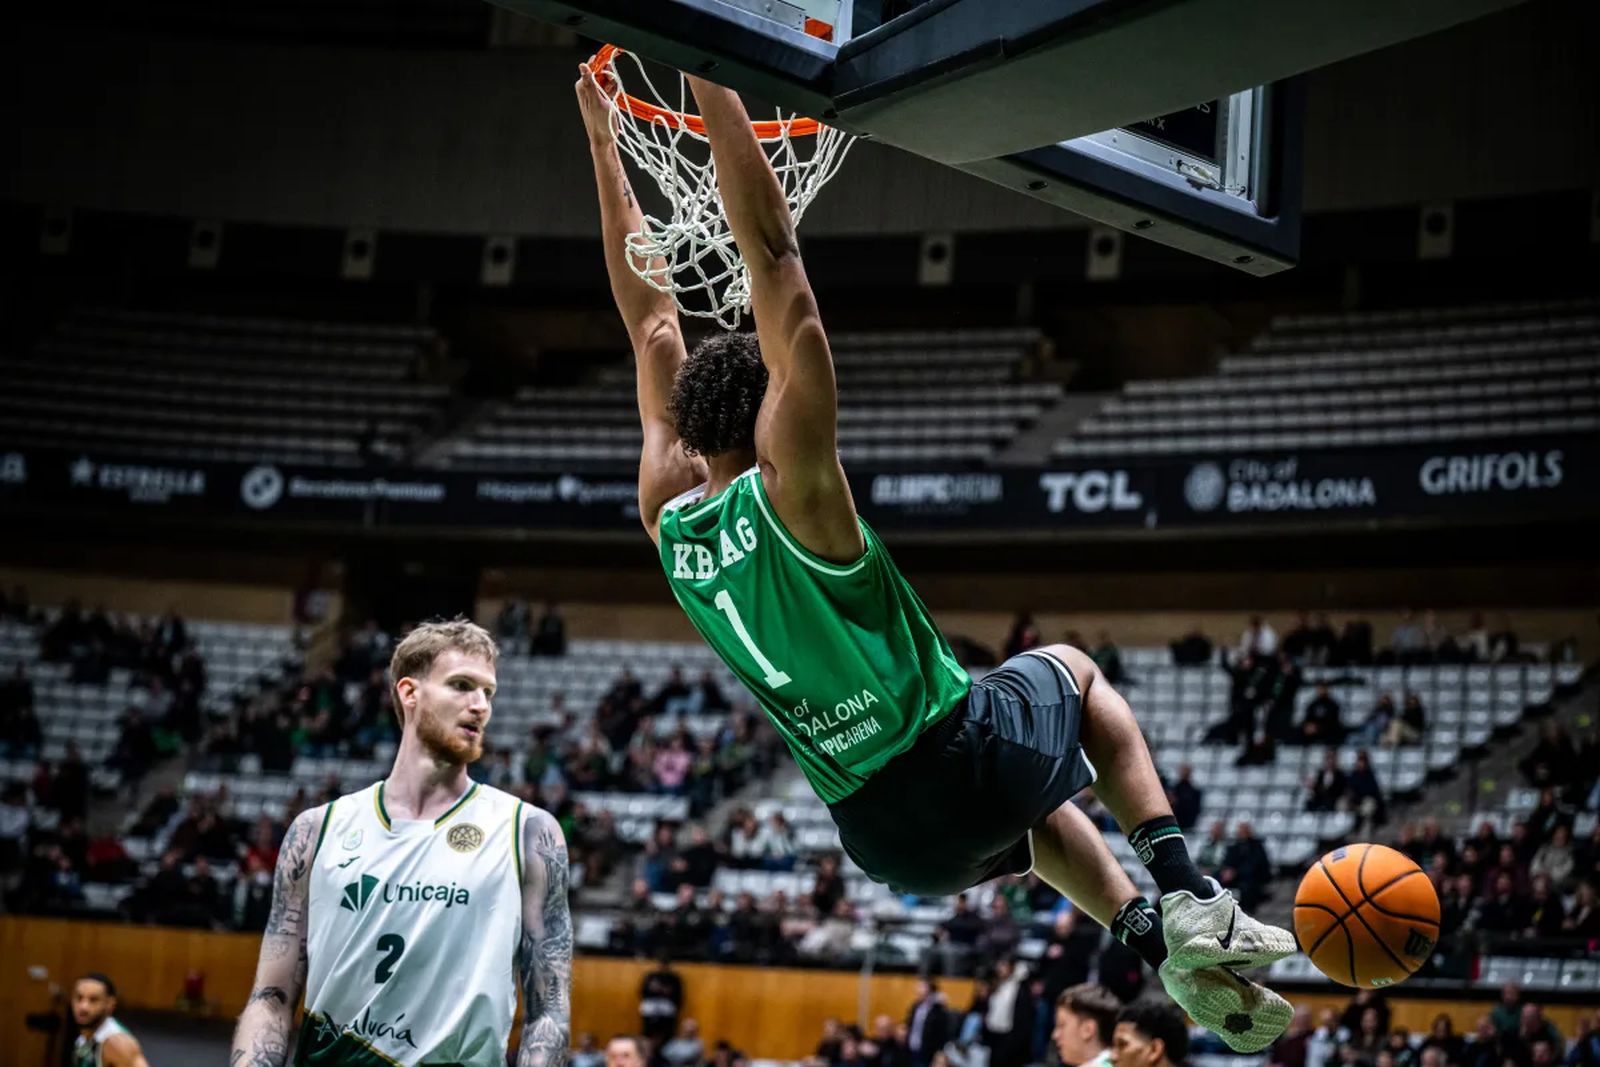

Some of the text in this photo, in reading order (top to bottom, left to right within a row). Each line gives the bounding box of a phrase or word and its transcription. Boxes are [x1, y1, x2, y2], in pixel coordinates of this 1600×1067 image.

[1229, 457, 1300, 483] City of
[1418, 449, 1564, 495] GRIFOLS
[1039, 469, 1143, 513] TCL
[1226, 477, 1377, 513] BADALONA
[714, 589, 792, 689] 1
[793, 698, 810, 718] of
[383, 881, 470, 908] Unicaja
[374, 933, 406, 984] 2
